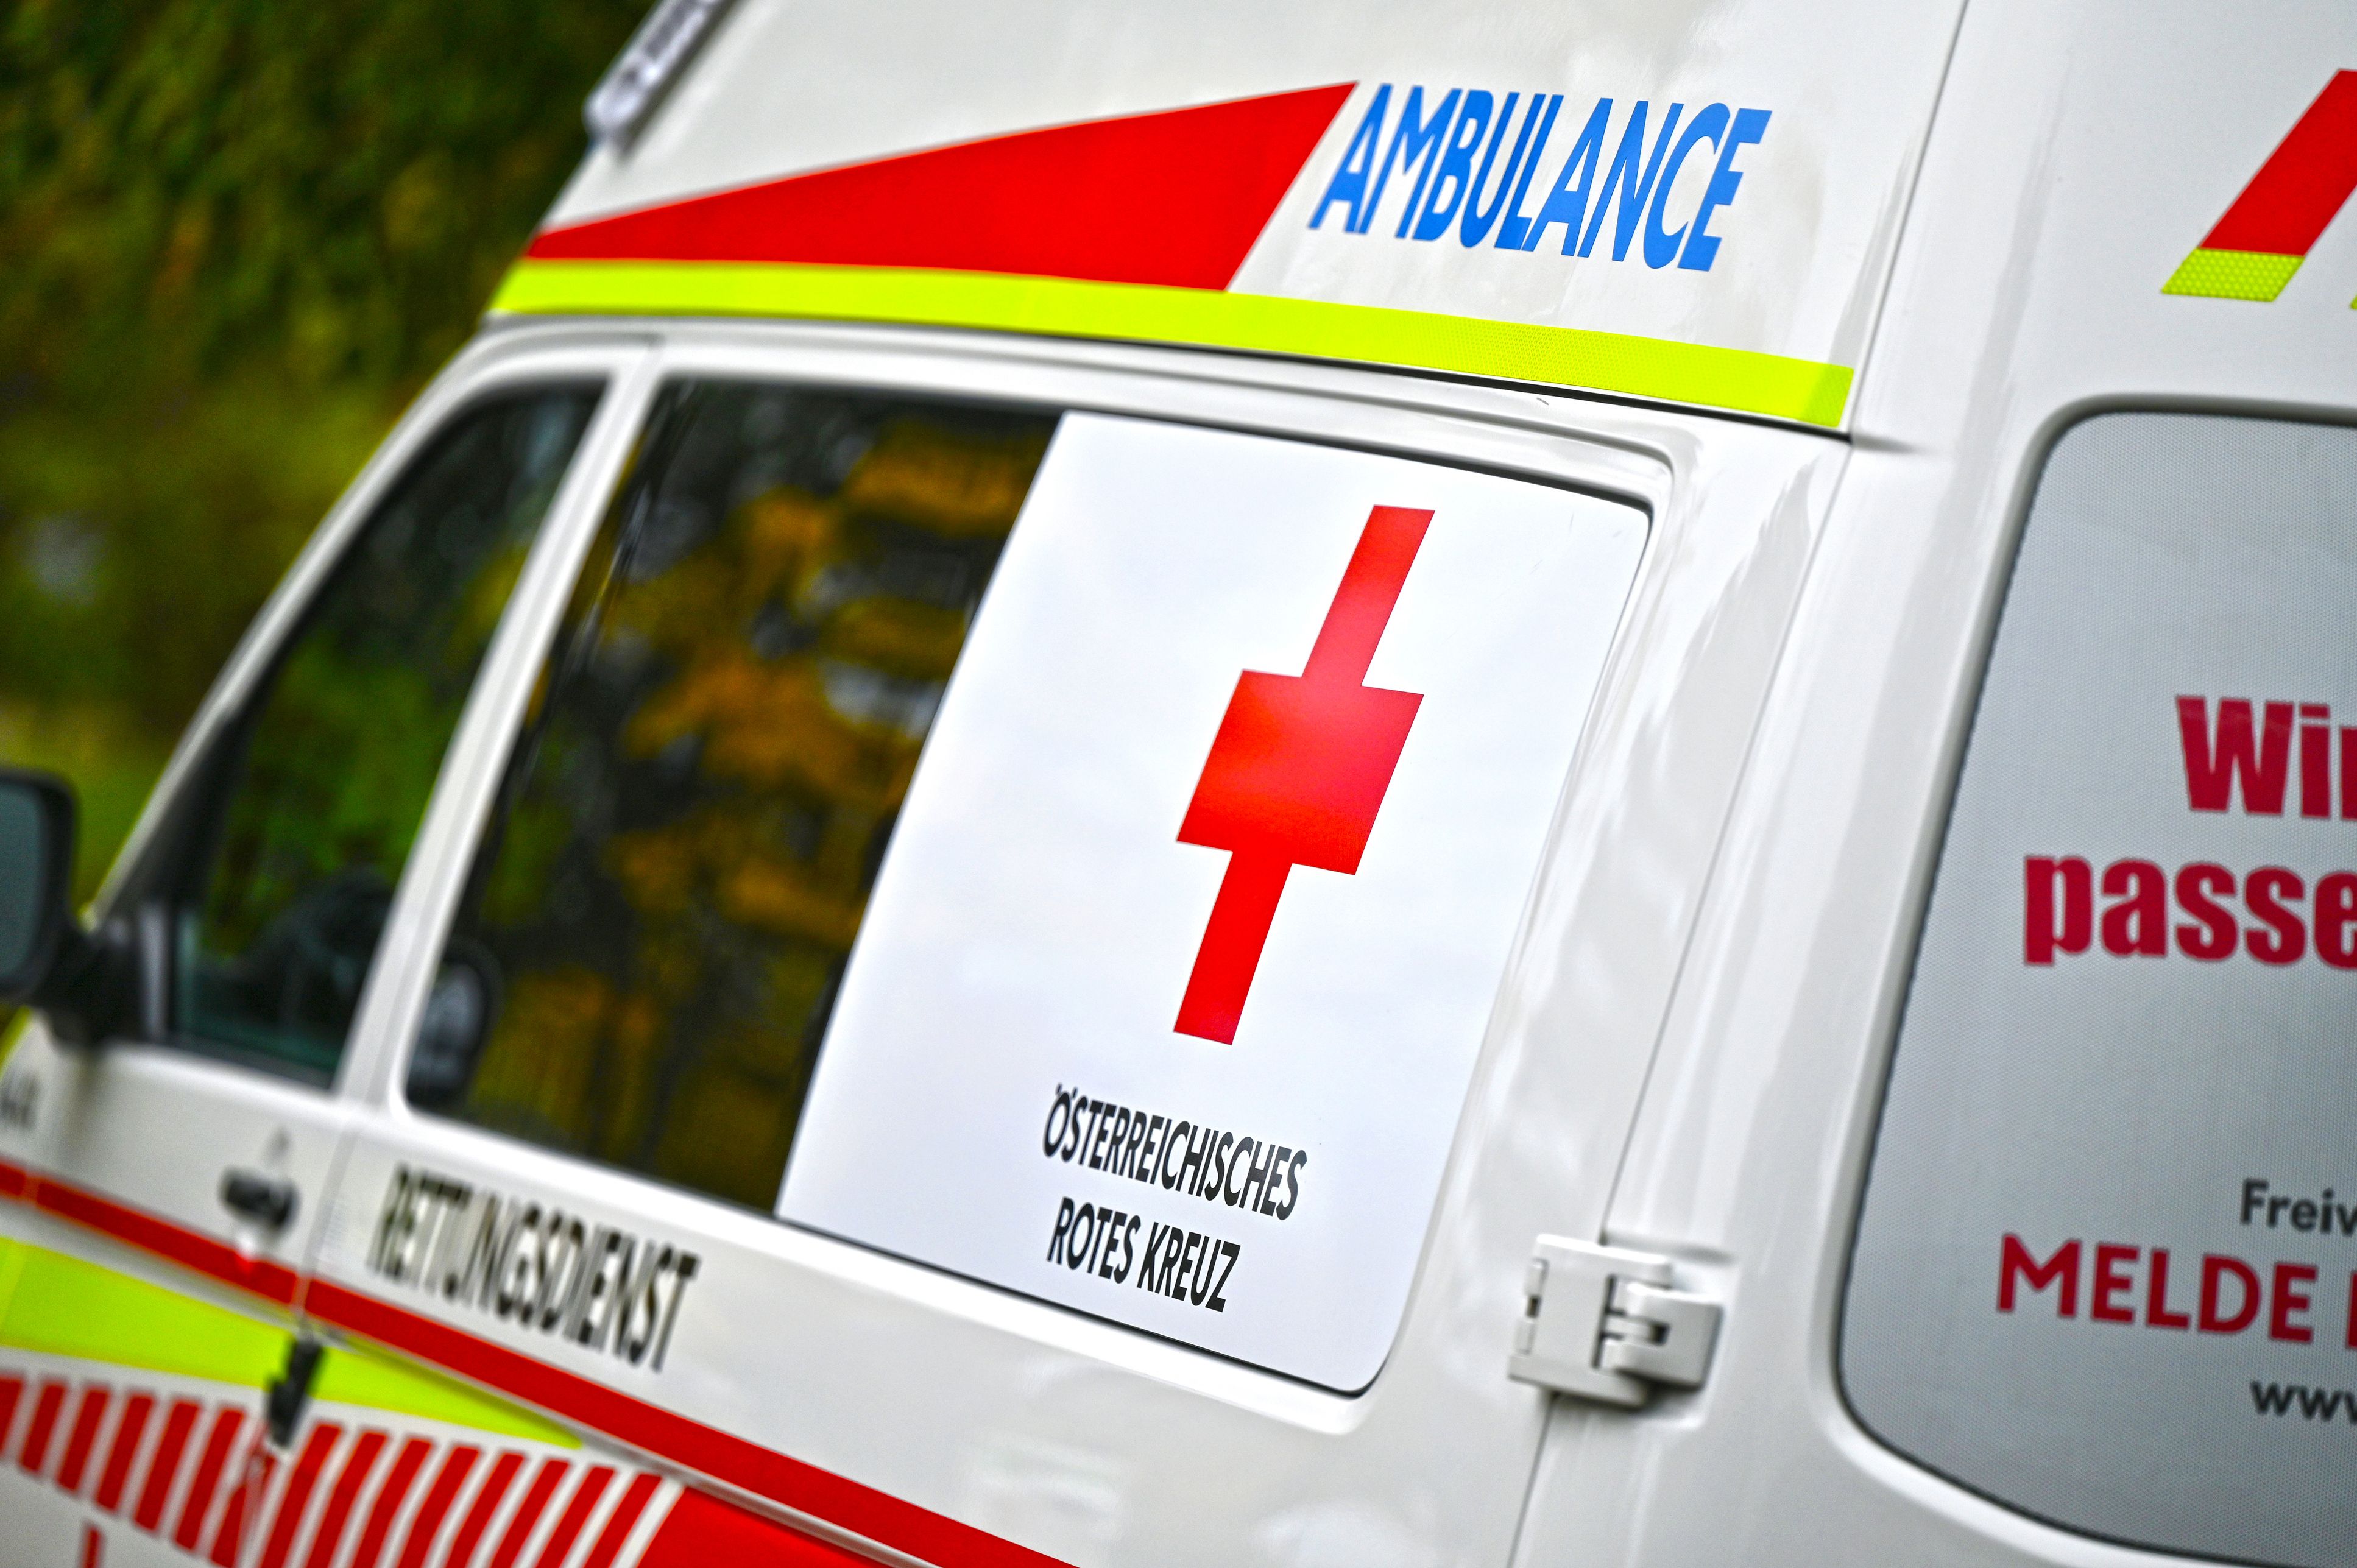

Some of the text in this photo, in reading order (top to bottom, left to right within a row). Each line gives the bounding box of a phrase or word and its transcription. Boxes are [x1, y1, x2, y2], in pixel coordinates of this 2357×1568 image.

[1307, 82, 1773, 272] AMBULANCE
[2024, 855, 2357, 972] passe
[1042, 1082, 1308, 1221] ÖSTERREICHISCHES
[366, 1162, 701, 1372] RETTUNGSDIENST
[1046, 1196, 1241, 1313] ROTES KREUZ
[1997, 1231, 2319, 1344] MELDE
[2250, 1380, 2357, 1424] ww
